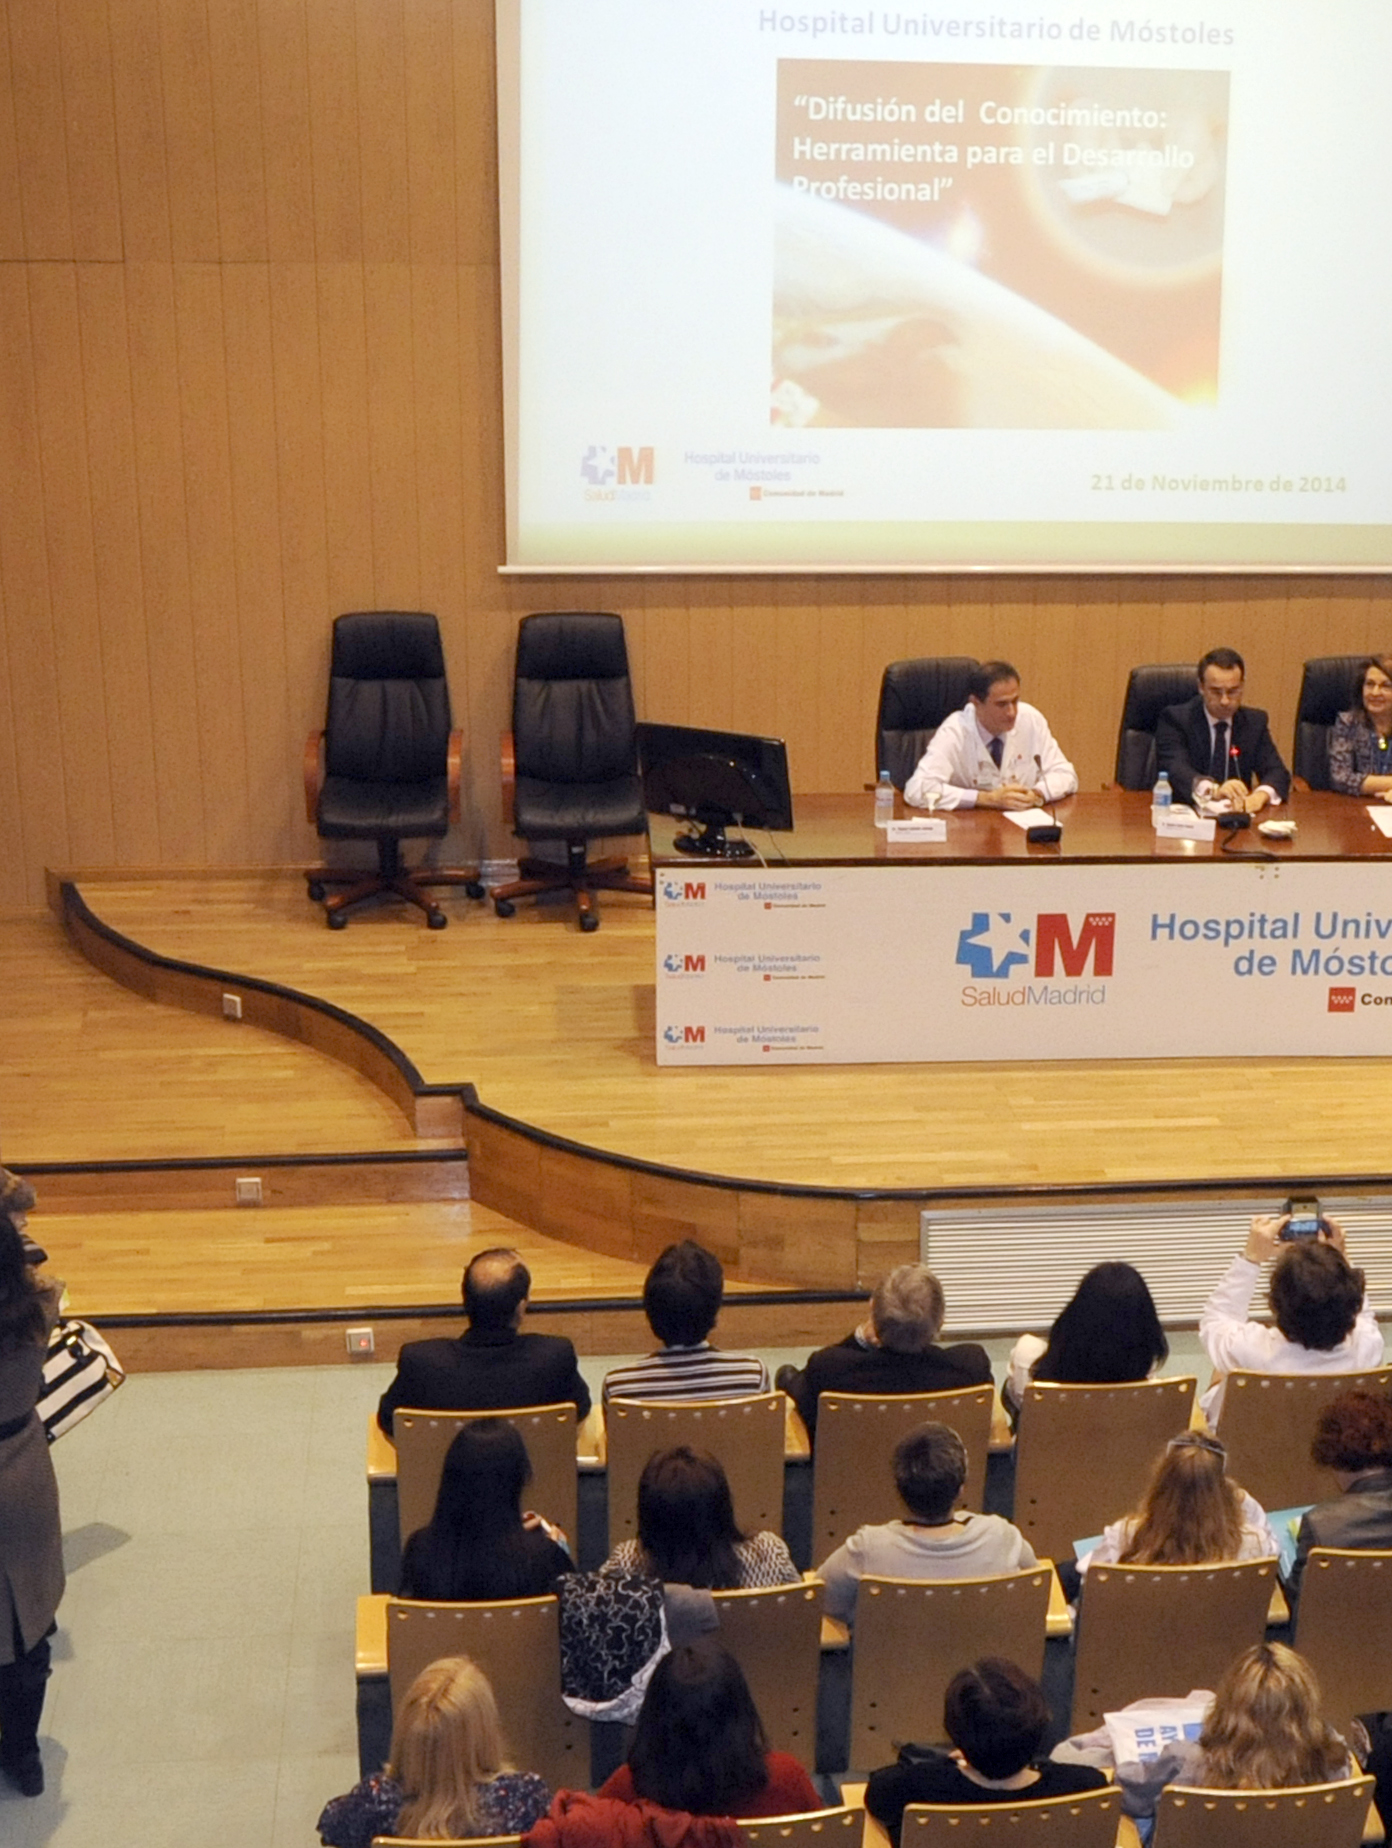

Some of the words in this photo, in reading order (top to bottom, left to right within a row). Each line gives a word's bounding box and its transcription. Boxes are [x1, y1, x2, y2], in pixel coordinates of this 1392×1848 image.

[759, 9, 875, 39] Hospital
[882, 13, 1063, 41] Universitario
[1068, 17, 1100, 42] de
[1110, 19, 1235, 45] Móstoles
[794, 95, 916, 123] “Difusión
[925, 98, 965, 124] del
[979, 101, 1168, 129] Conocimiento:
[793, 137, 958, 164] Herramienta
[966, 143, 1024, 169] para
[1032, 142, 1055, 166] el
[1063, 143, 1195, 169] Desarrollo
[684, 451, 737, 467] Hospital
[739, 451, 821, 465] Universitario
[714, 468, 732, 481] de
[733, 468, 791, 481] Móstoles
[1091, 474, 1115, 491] 21
[1121, 473, 1146, 491] de
[1151, 473, 1264, 492] Noviembre
[1269, 474, 1293, 492] de
[1299, 475, 1347, 493] 2014
[1151, 911, 1300, 947] Hospital
[1034, 912, 1116, 977] M
[1233, 949, 1277, 976] de
[961, 985, 1106, 1007] SaludMadrid
